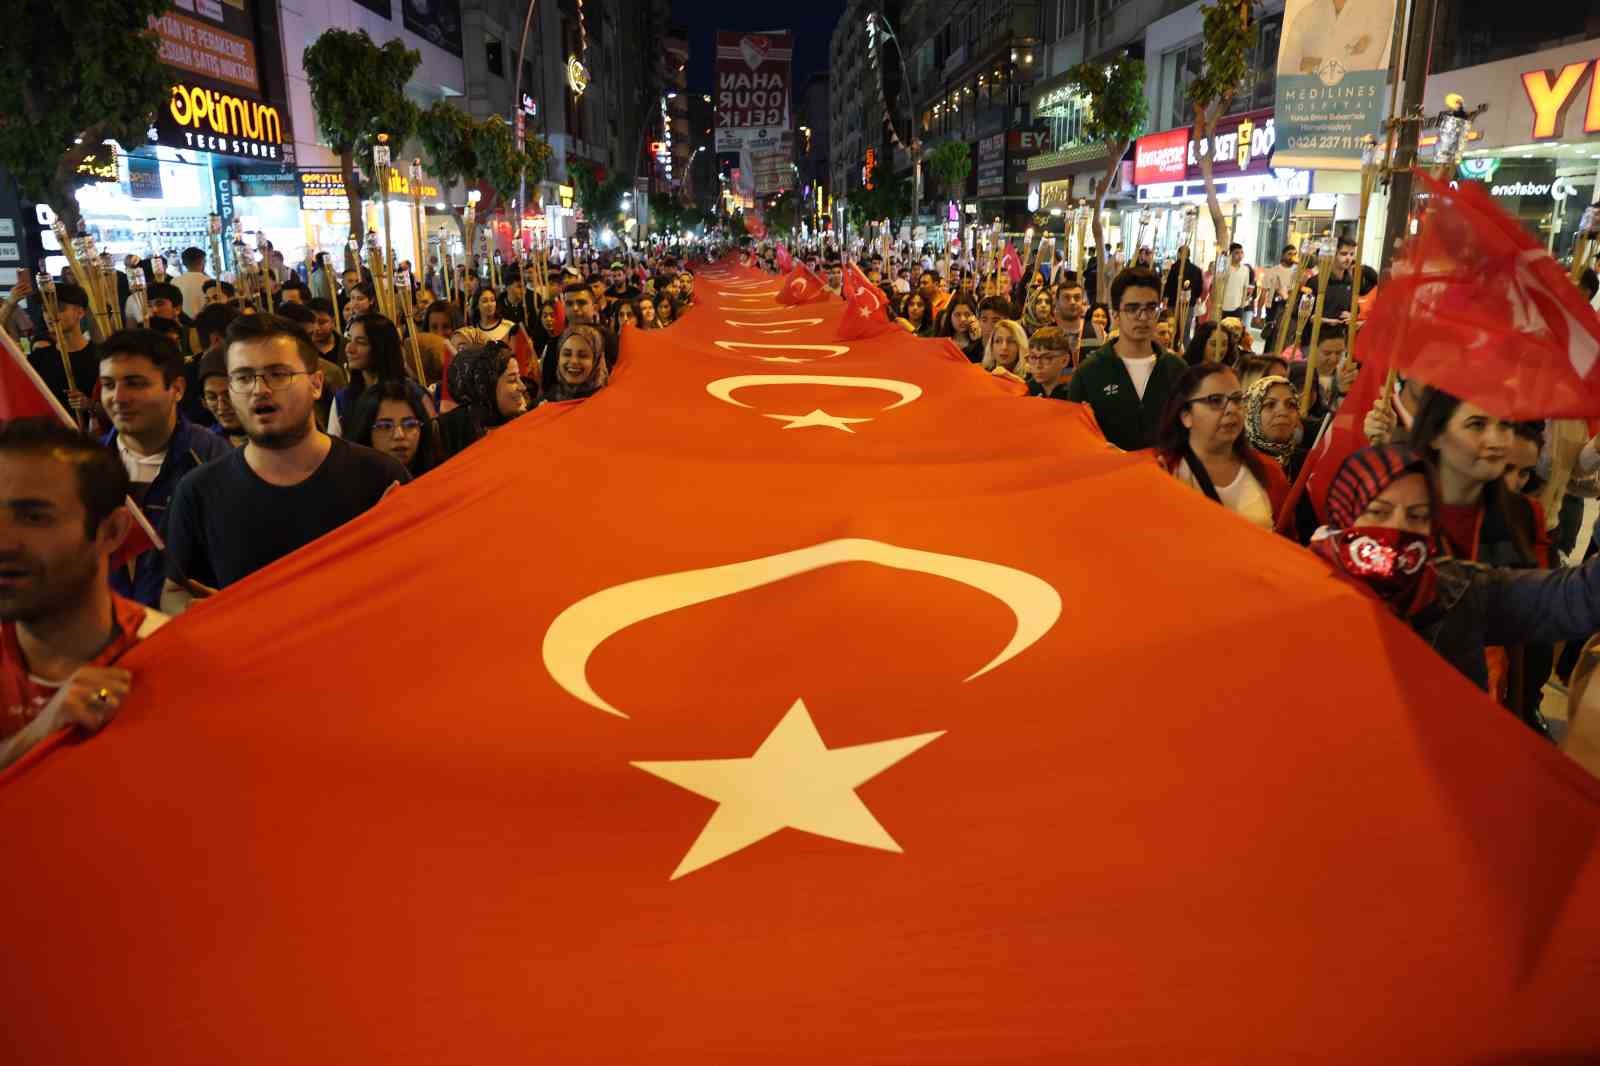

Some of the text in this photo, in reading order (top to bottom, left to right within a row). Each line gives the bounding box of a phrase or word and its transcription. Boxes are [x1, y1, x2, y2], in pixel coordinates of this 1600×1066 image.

[1286, 85, 1376, 100] MEDILINES
[185, 132, 227, 151] TECH
[232, 140, 276, 159] STORE
